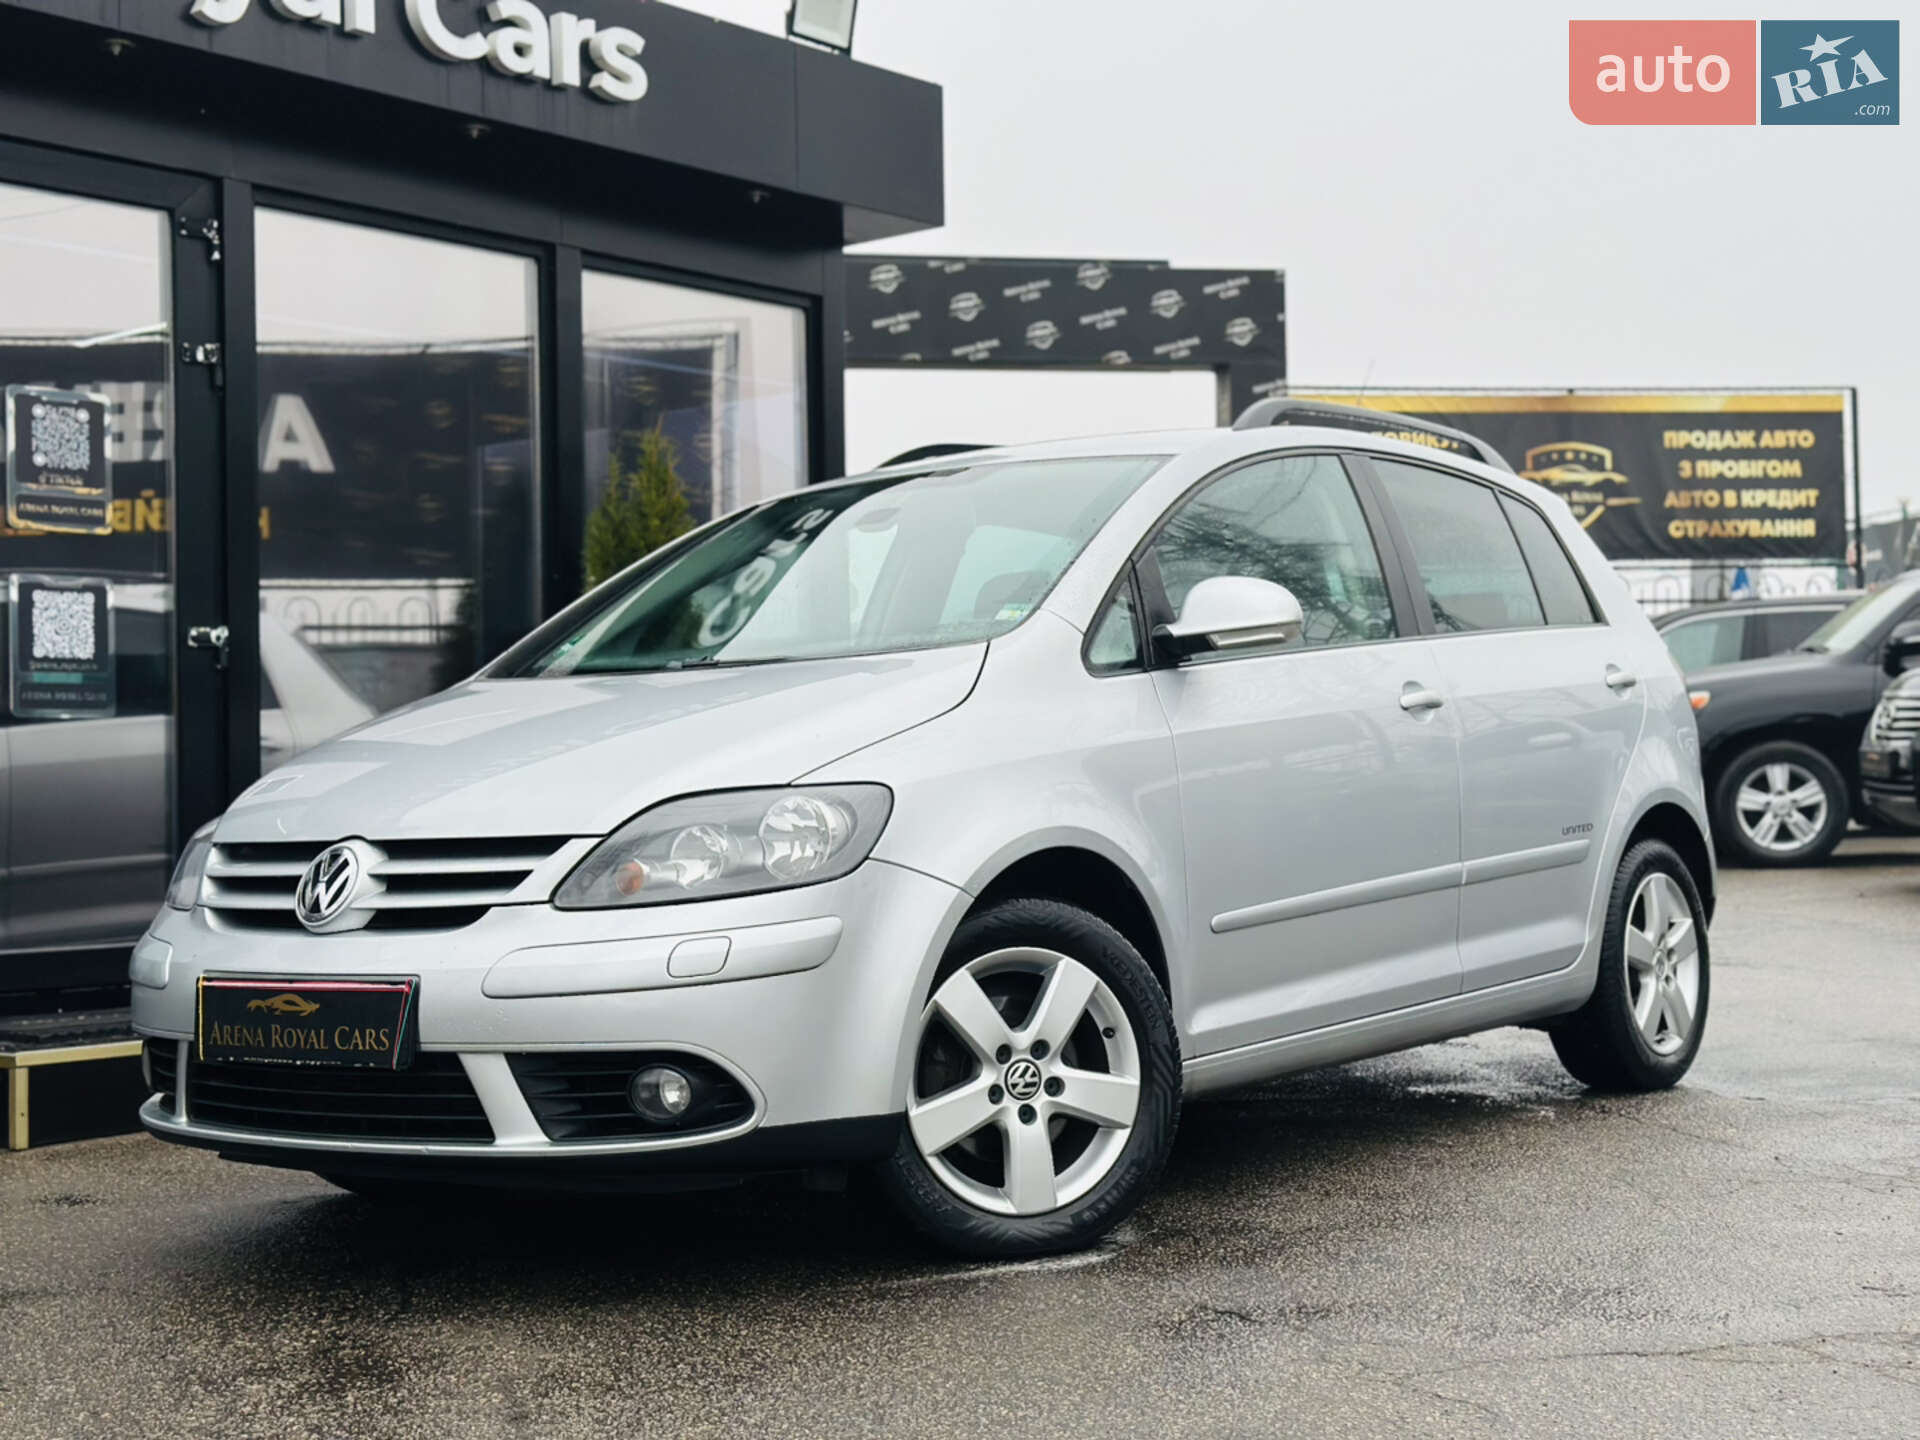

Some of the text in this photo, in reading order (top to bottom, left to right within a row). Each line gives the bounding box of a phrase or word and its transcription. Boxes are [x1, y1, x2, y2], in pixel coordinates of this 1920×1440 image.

[1663, 430, 1816, 450] ПРОДАЖ АВТО
[1695, 459, 1803, 479] ПРОБІГОМ
[1664, 489, 1820, 510] АВТО В КРЕДИТ
[1667, 518, 1817, 539] СТРАХУВАННЯ
[1561, 822, 1594, 836] UNITED
[209, 1021, 391, 1051] ARENA ROYAL CARS
